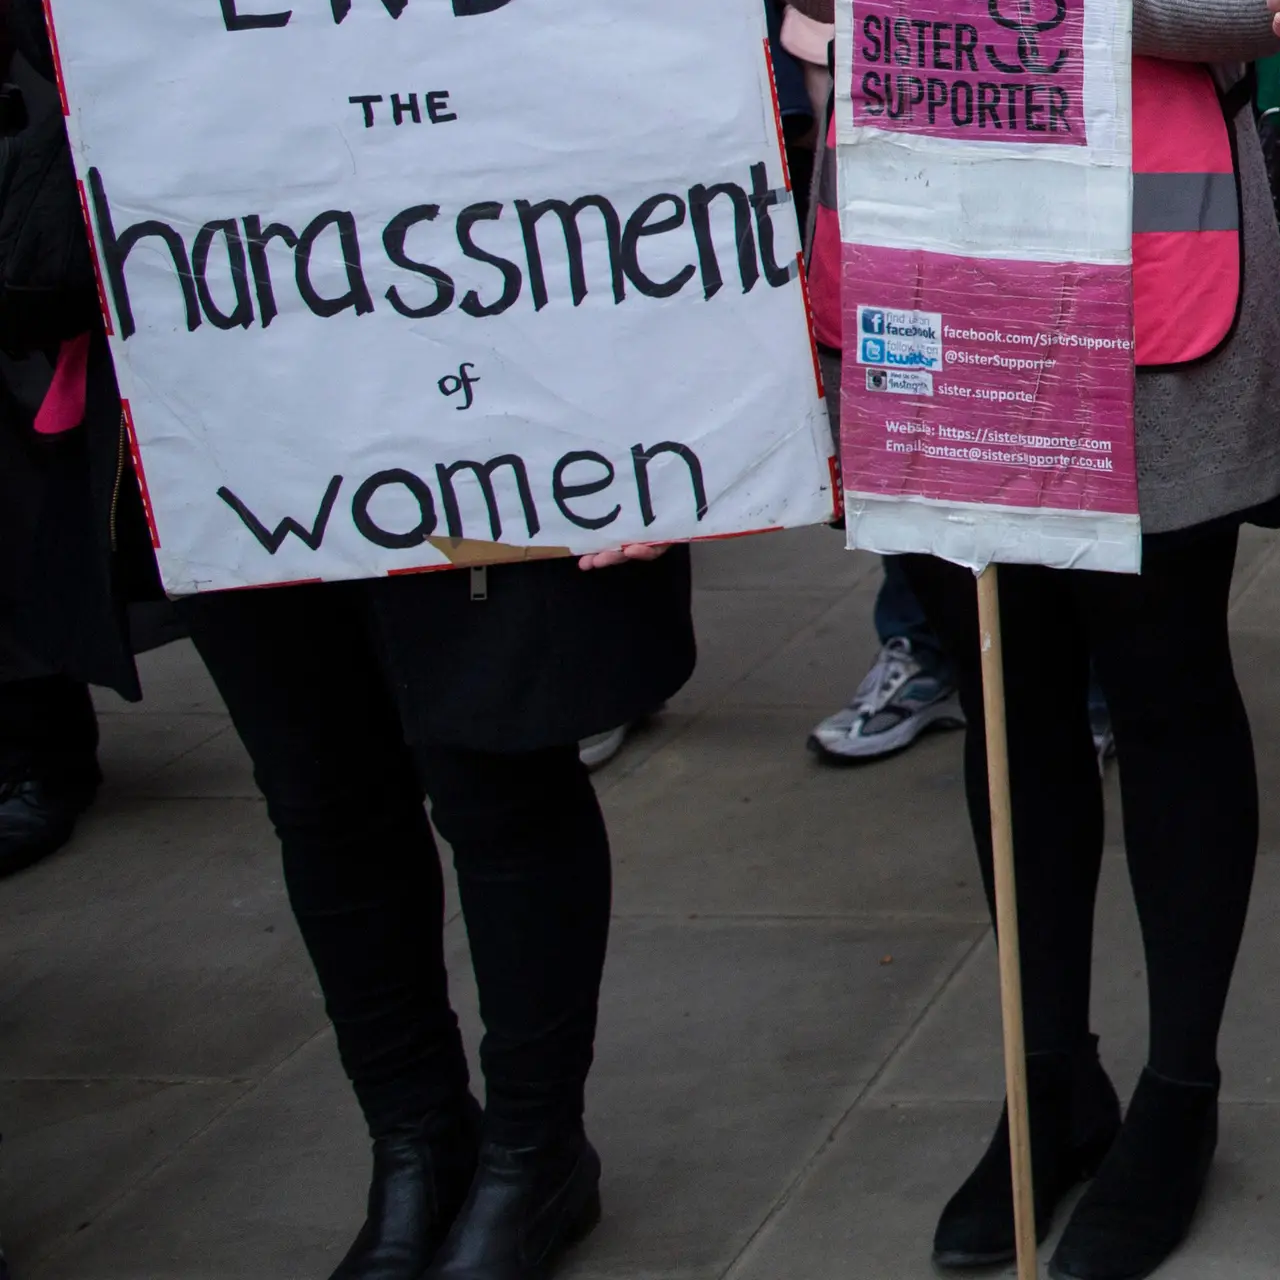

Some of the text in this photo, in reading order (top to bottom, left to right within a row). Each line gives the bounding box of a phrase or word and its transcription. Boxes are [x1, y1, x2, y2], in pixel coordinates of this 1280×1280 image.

[862, 13, 978, 73] SISTER
[349, 91, 458, 129] THE
[861, 70, 1072, 134] SUPPORTER
[88, 160, 799, 341] harassment
[437, 362, 481, 411] of
[218, 439, 711, 556] women
